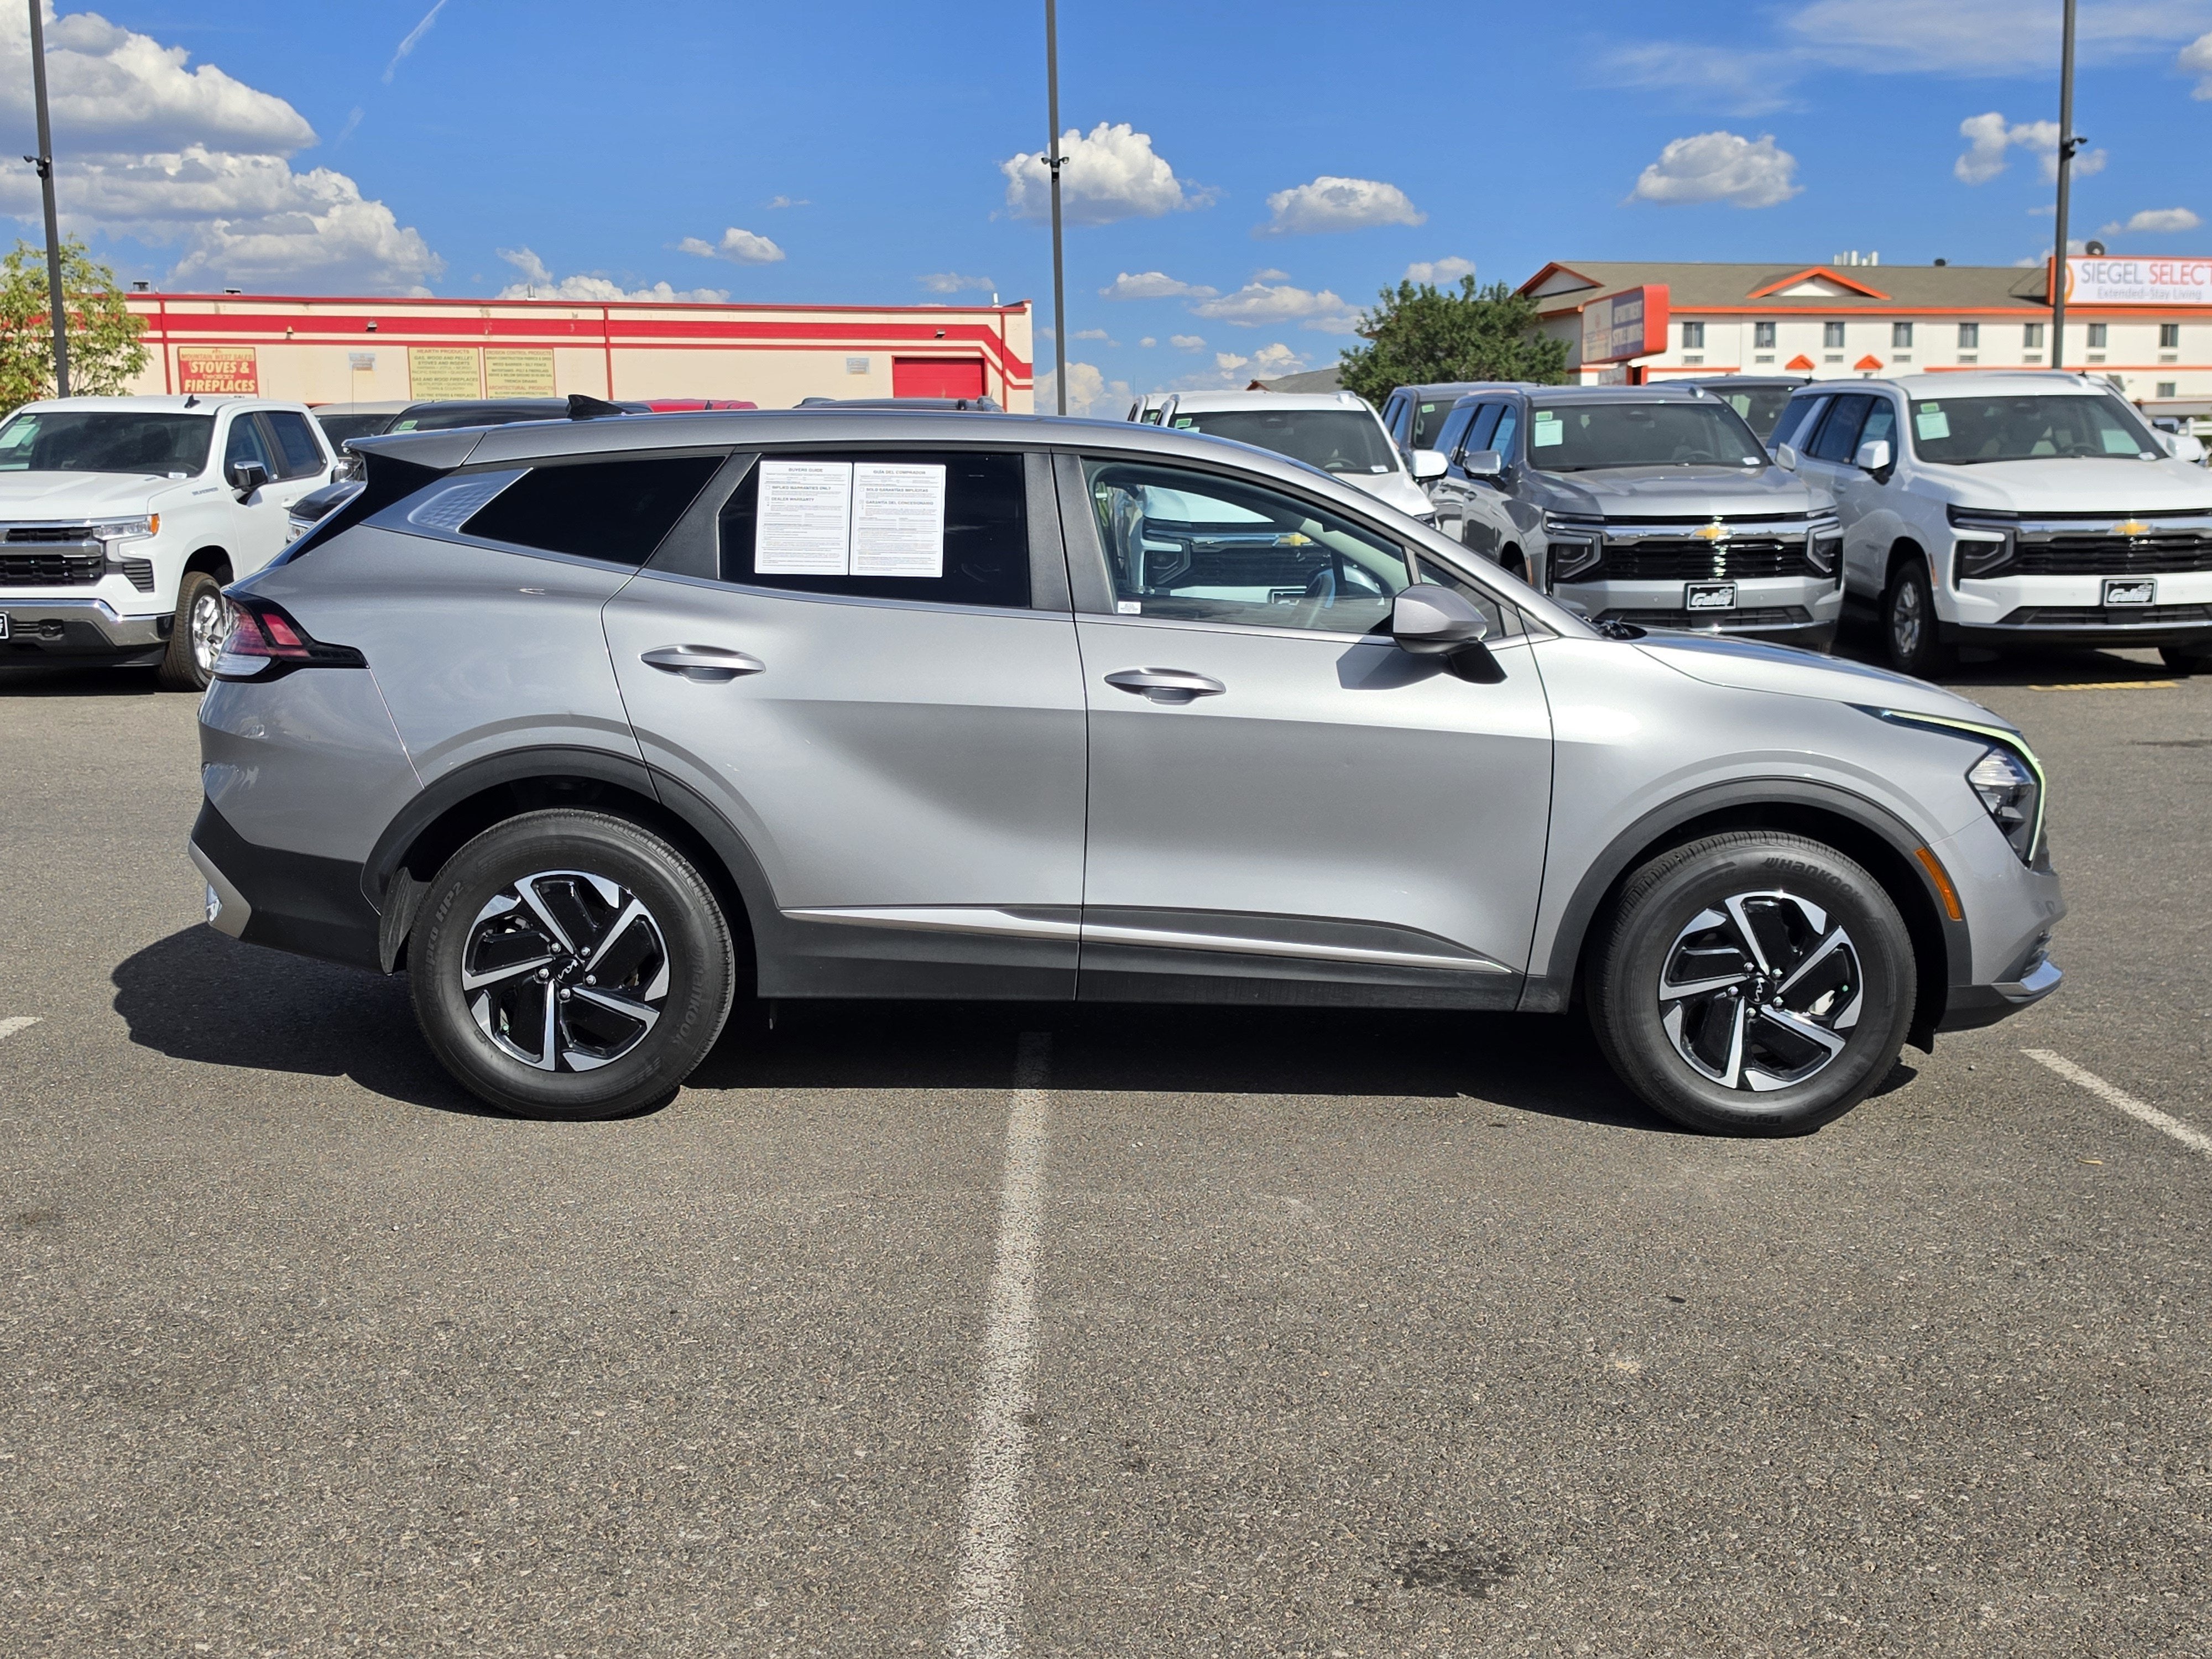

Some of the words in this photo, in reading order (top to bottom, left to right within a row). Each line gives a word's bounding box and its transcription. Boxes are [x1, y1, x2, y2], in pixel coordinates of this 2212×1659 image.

[2081, 262, 2144, 285] SIEGEL
[2173, 287, 2201, 300] Living
[190, 361, 237, 374] STOVES
[239, 362, 249, 374] &
[184, 379, 255, 392] FIREPLACES
[435, 881, 463, 922] HP2
